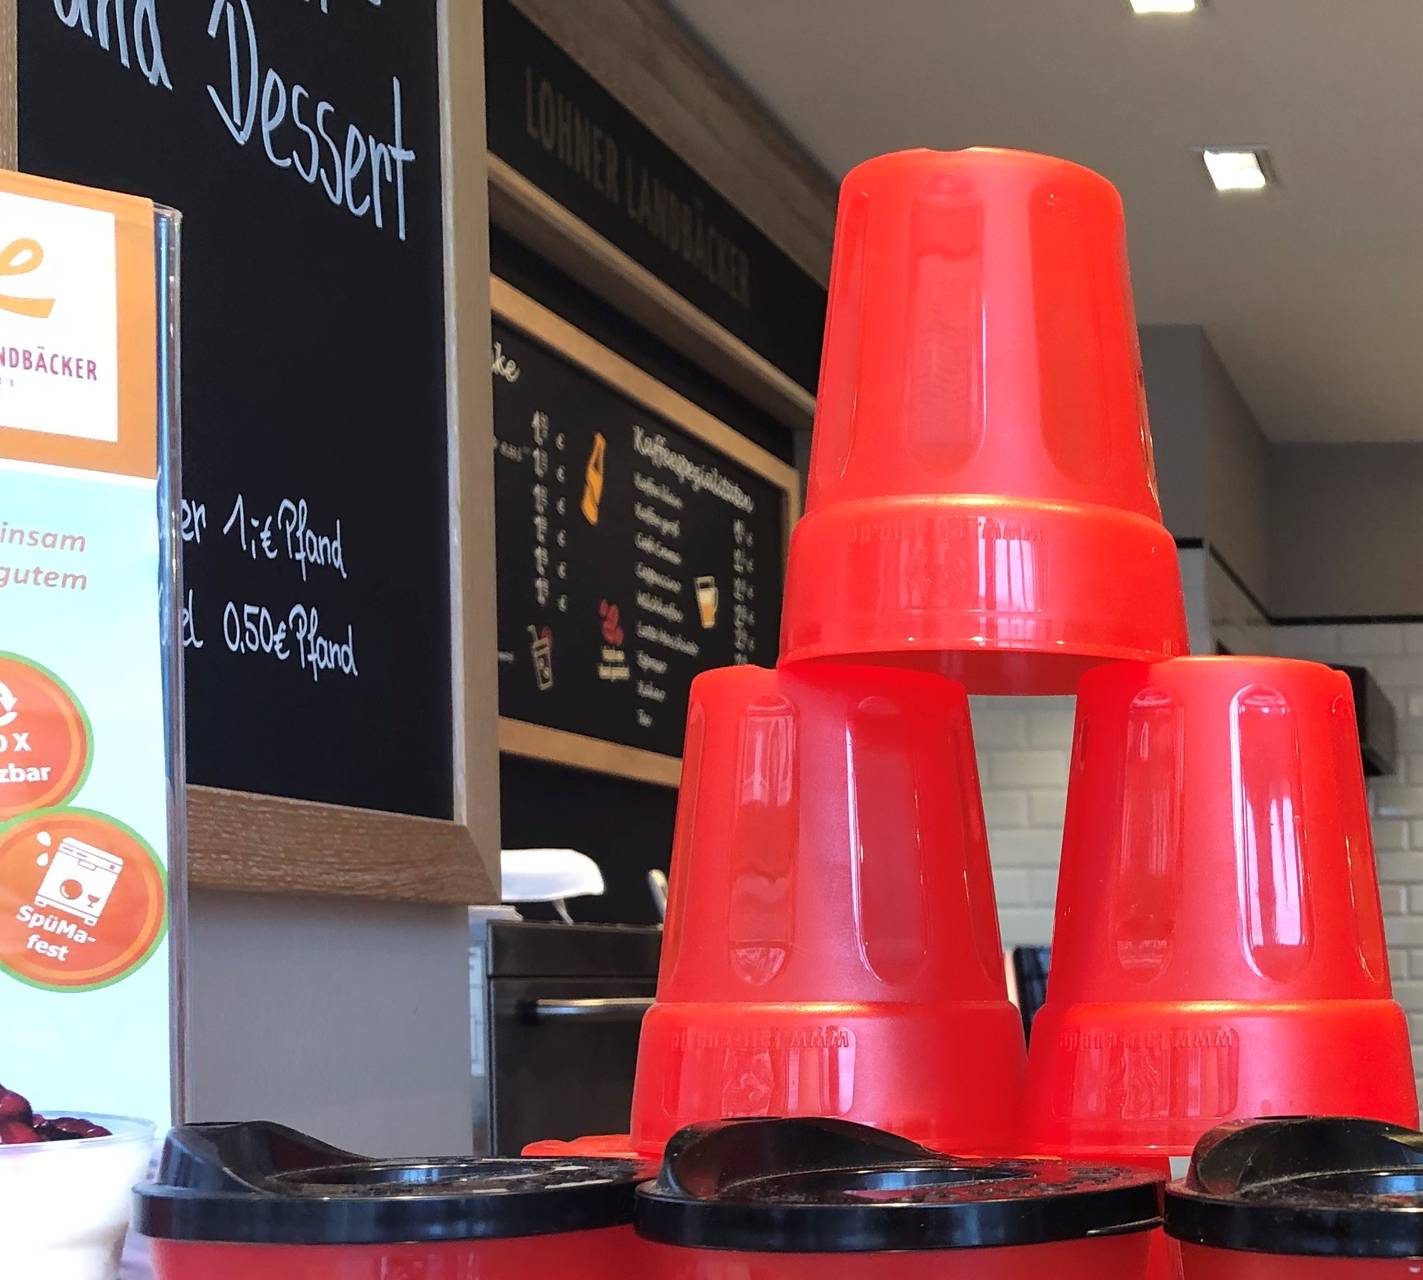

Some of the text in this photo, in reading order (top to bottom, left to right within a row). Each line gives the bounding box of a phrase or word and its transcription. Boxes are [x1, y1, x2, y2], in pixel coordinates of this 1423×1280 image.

[206, 0, 415, 241] Dessert
[525, 64, 620, 205] LOHNER
[0, 565, 88, 591] gutem
[278, 498, 348, 583] Pfand
[288, 603, 359, 683] Pfand
[15, 904, 97, 945] SpüMa-
[26, 934, 71, 963] fest
